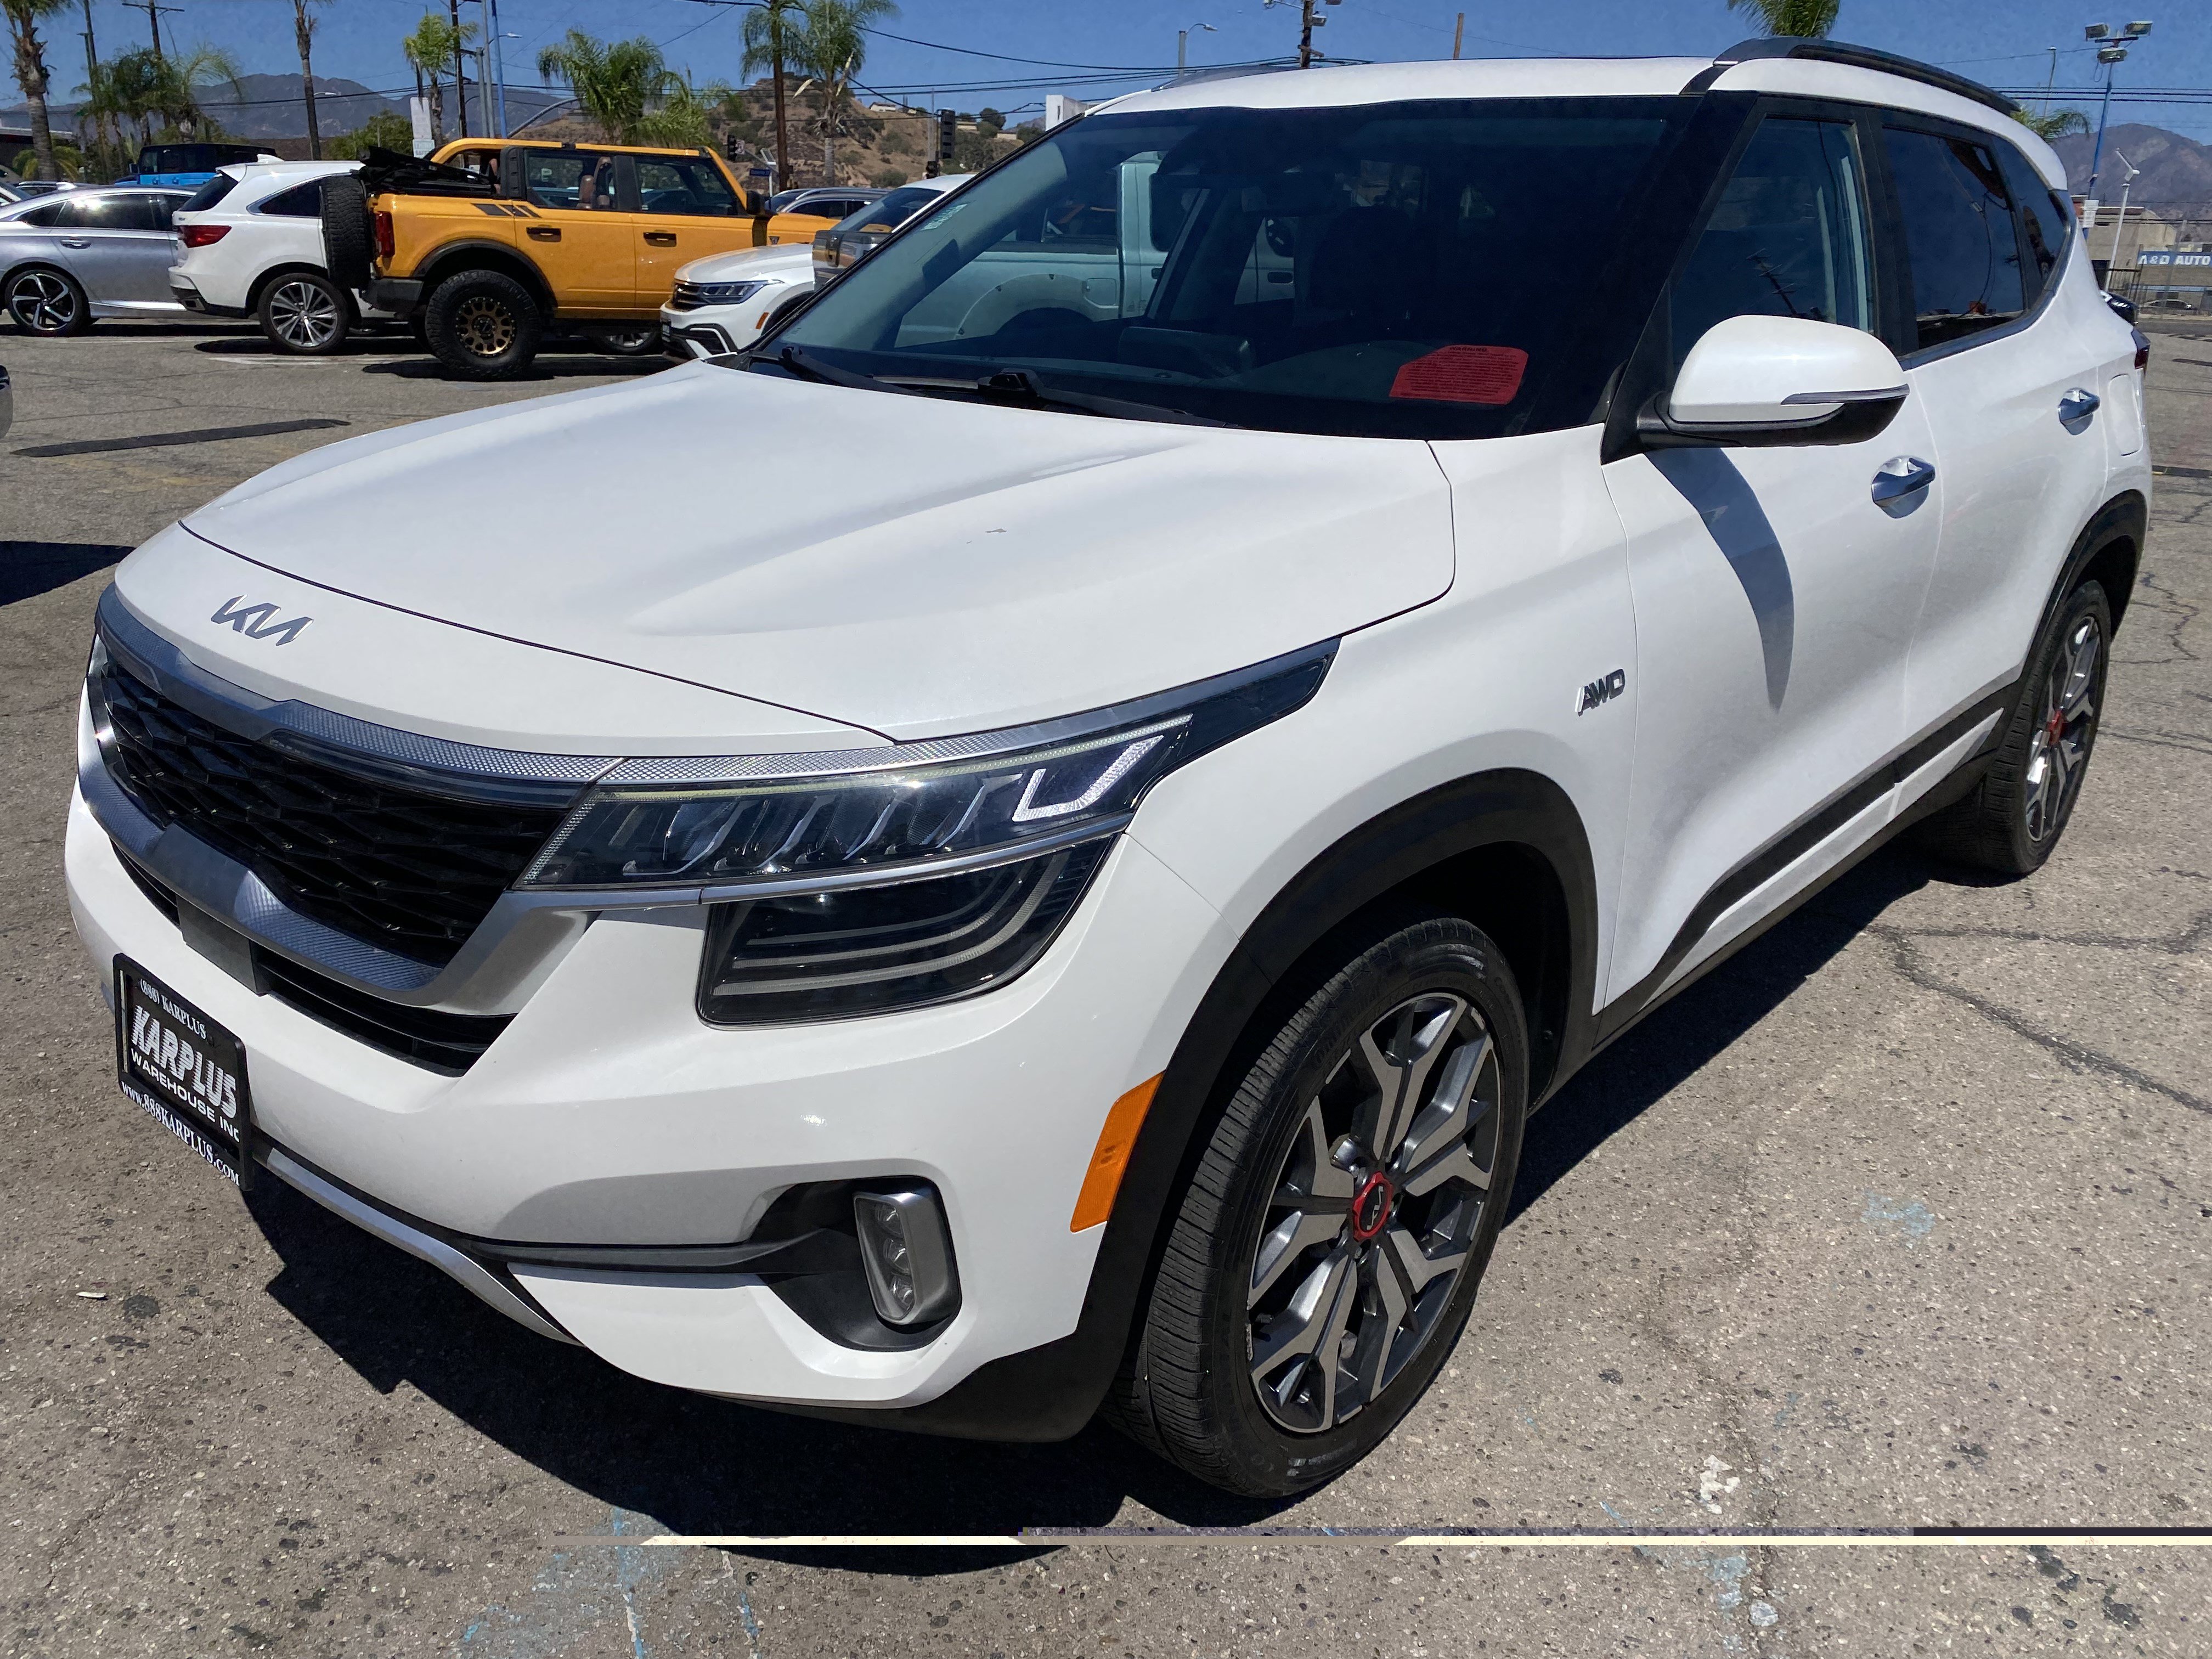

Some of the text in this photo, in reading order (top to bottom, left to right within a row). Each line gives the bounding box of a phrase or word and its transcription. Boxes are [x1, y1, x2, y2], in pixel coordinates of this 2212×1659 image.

[2137, 255, 2211, 265] A & D AUTO
[211, 594, 314, 646] KIA
[1575, 669, 1626, 716] AWD
[140, 978, 207, 1040] (888) KARPLUS
[131, 1005, 237, 1119] KARPLUS
[131, 1048, 216, 1122] WAREHOUSE
